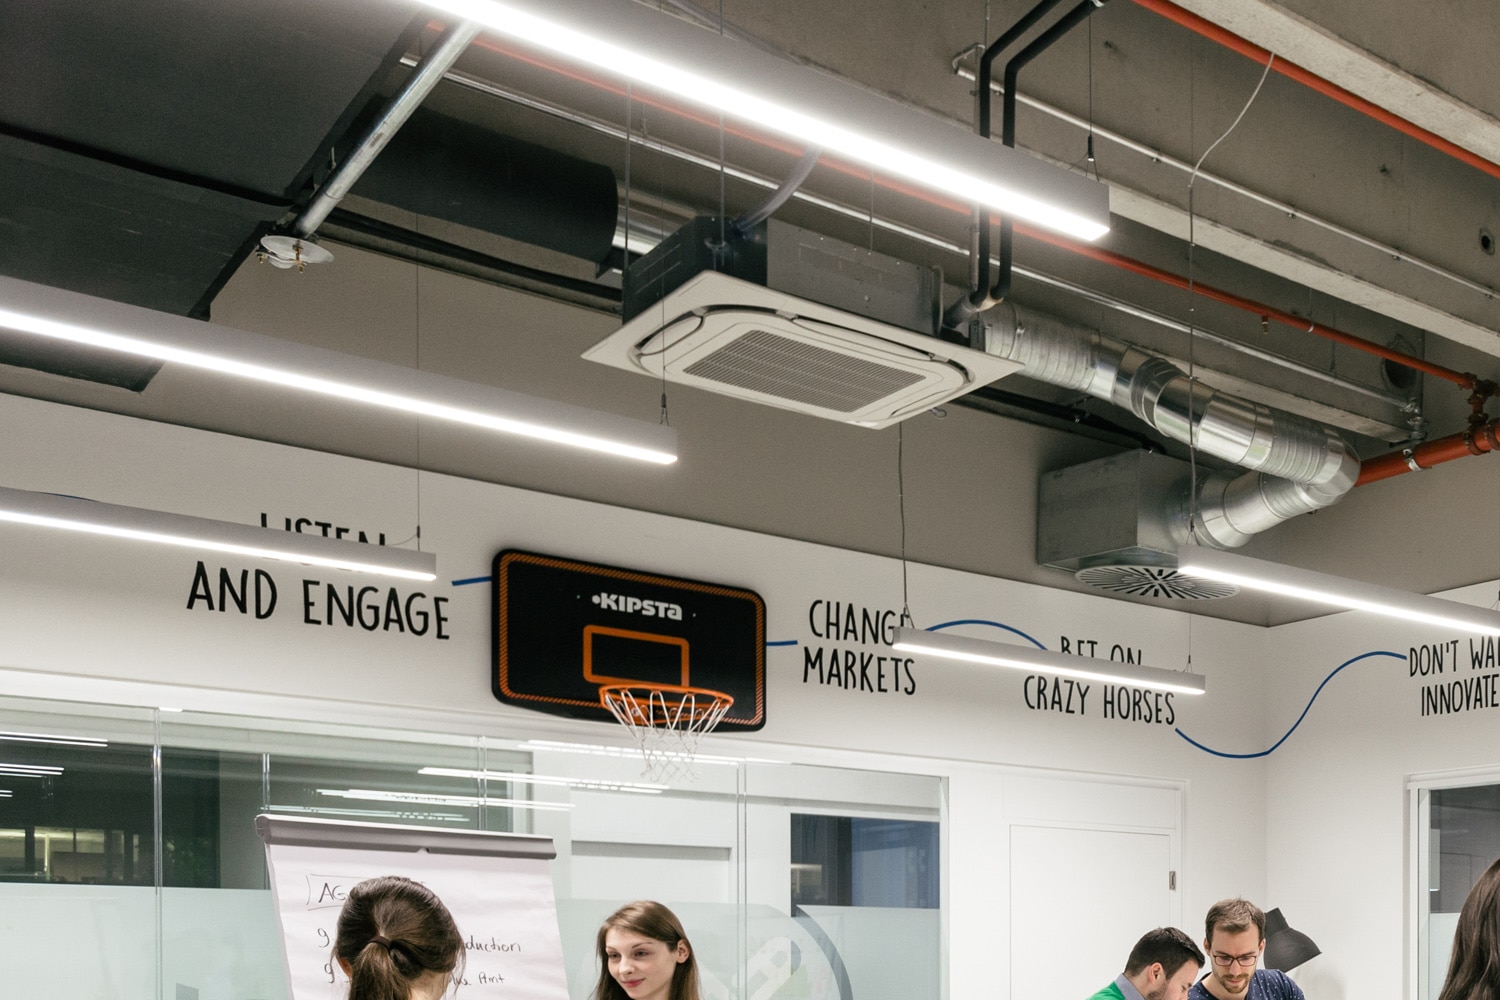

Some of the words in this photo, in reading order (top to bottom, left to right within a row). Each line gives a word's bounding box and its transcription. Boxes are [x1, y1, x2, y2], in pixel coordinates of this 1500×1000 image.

[186, 561, 278, 620] AND
[303, 579, 450, 640] ENGAGE
[803, 646, 916, 695] MARKETS
[1409, 639, 1459, 677] DON'T
[1024, 675, 1090, 715] CRAZY
[1103, 684, 1175, 725] HORSES
[1421, 674, 1500, 717] INNOVATE
[464, 935, 522, 952] duction
